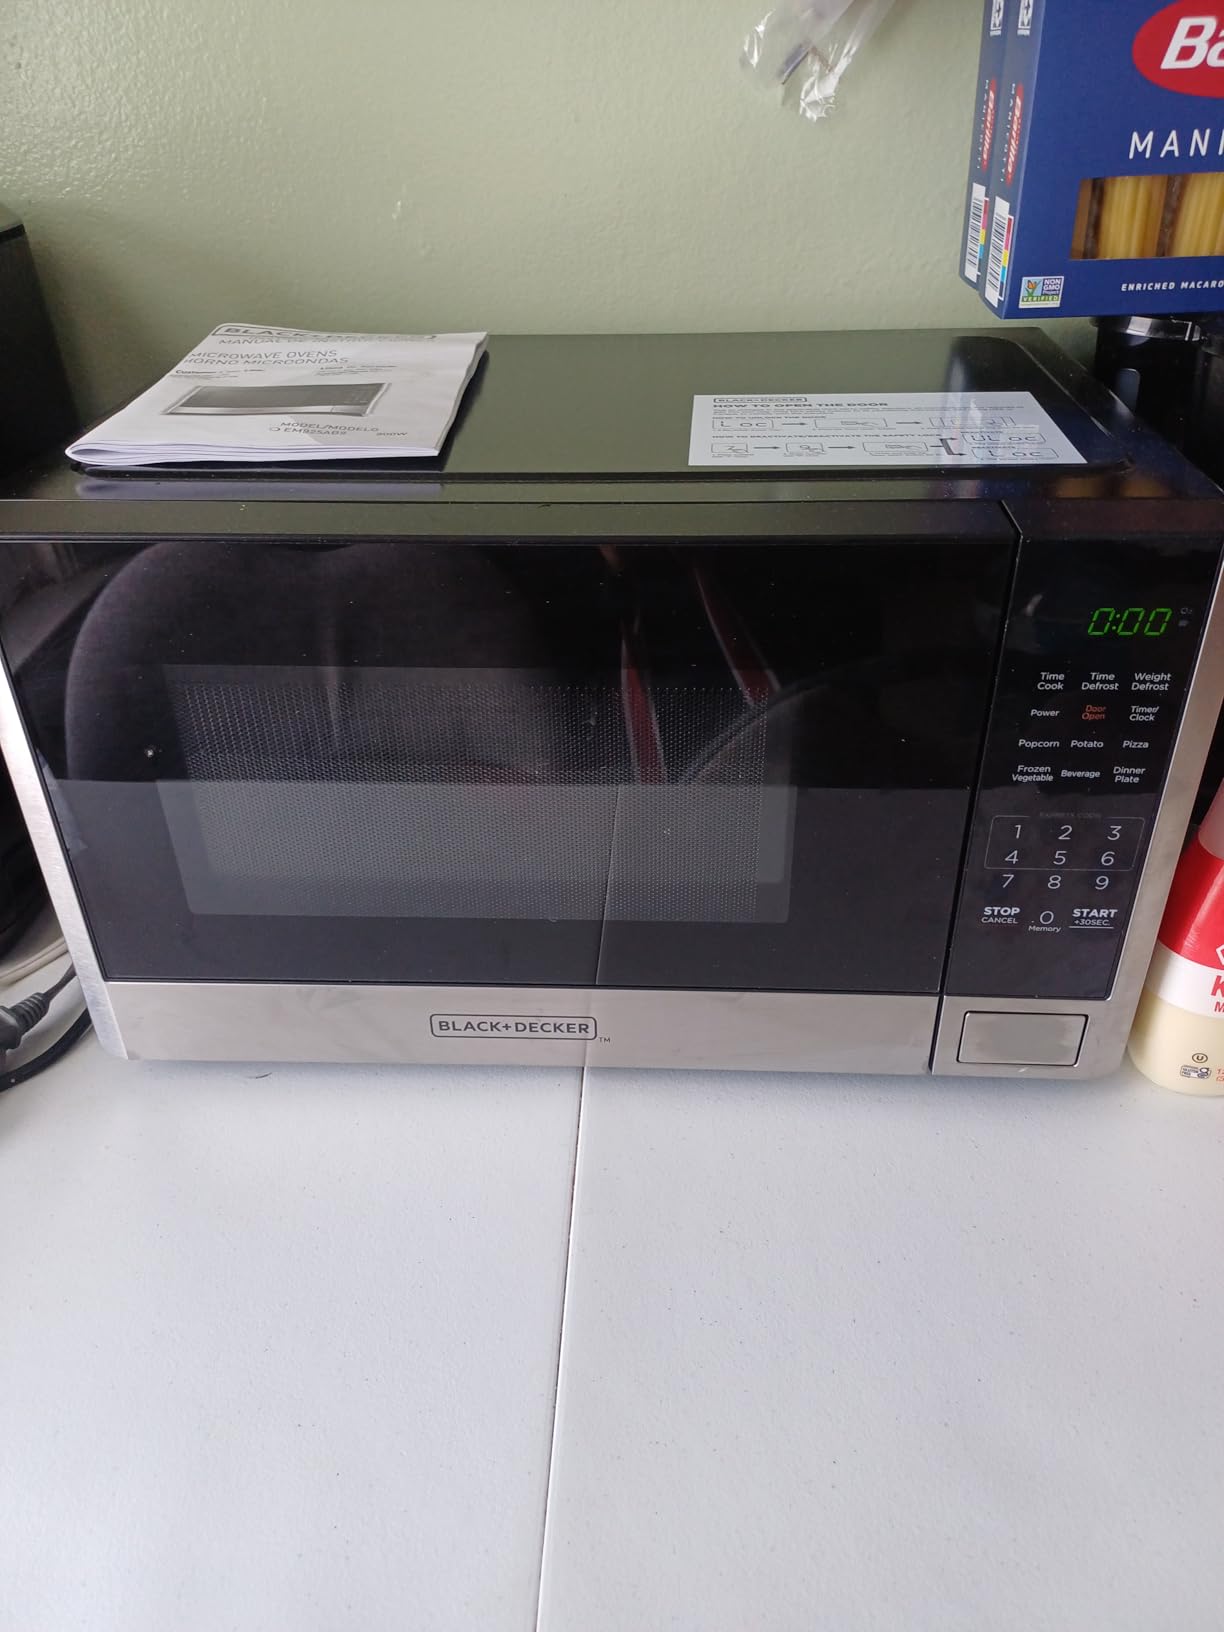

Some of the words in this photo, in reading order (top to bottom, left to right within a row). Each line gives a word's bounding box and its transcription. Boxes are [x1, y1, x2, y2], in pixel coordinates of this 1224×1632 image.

[1007, 95, 1022, 173] Barilla
[1121, 281, 1176, 292] ENRICHED
[191, 351, 282, 360] MICROWAVE
[287, 349, 338, 359] OVENS
[280, 422, 379, 432] MODEL/MODELO
[1087, 607, 1173, 636] 0:00
[1040, 671, 1065, 681] Time
[1090, 671, 1116, 681] Time
[1134, 671, 1172, 682] Weight
[1037, 681, 1064, 690] Cook
[1081, 681, 1120, 691] Defrost
[1131, 682, 1170, 691] Defrost
[1030, 708, 1061, 717] Power
[1085, 704, 1107, 713] Door
[1130, 705, 1160, 714] Timer/
[1081, 712, 1105, 721] Open
[1129, 713, 1156, 722] Clock
[1018, 738, 1060, 748] Popcorn
[1070, 739, 1104, 748] Potato
[1122, 739, 1149, 749] Pizza
[1017, 764, 1052, 773] Frozen
[1112, 766, 1147, 775] Dinner
[1011, 773, 1054, 783] Vegetable
[1060, 769, 1101, 779] Beverage
[1114, 775, 1141, 784] Plate
[1014, 824, 1022, 839] 1
[1057, 824, 1073, 841] 2
[1107, 825, 1122, 841] 3
[1004, 849, 1019, 865] 4
[1053, 850, 1067, 866] 5
[1100, 851, 1115, 867] 6
[1001, 873, 1015, 889] 7
[1047, 874, 1062, 890] 8
[1094, 875, 1110, 891] 9
[983, 906, 1021, 916] STOP
[1072, 908, 1119, 918] START
[1028, 925, 1062, 933] Memory
[438, 1020, 590, 1034] BLACK+DECKER
